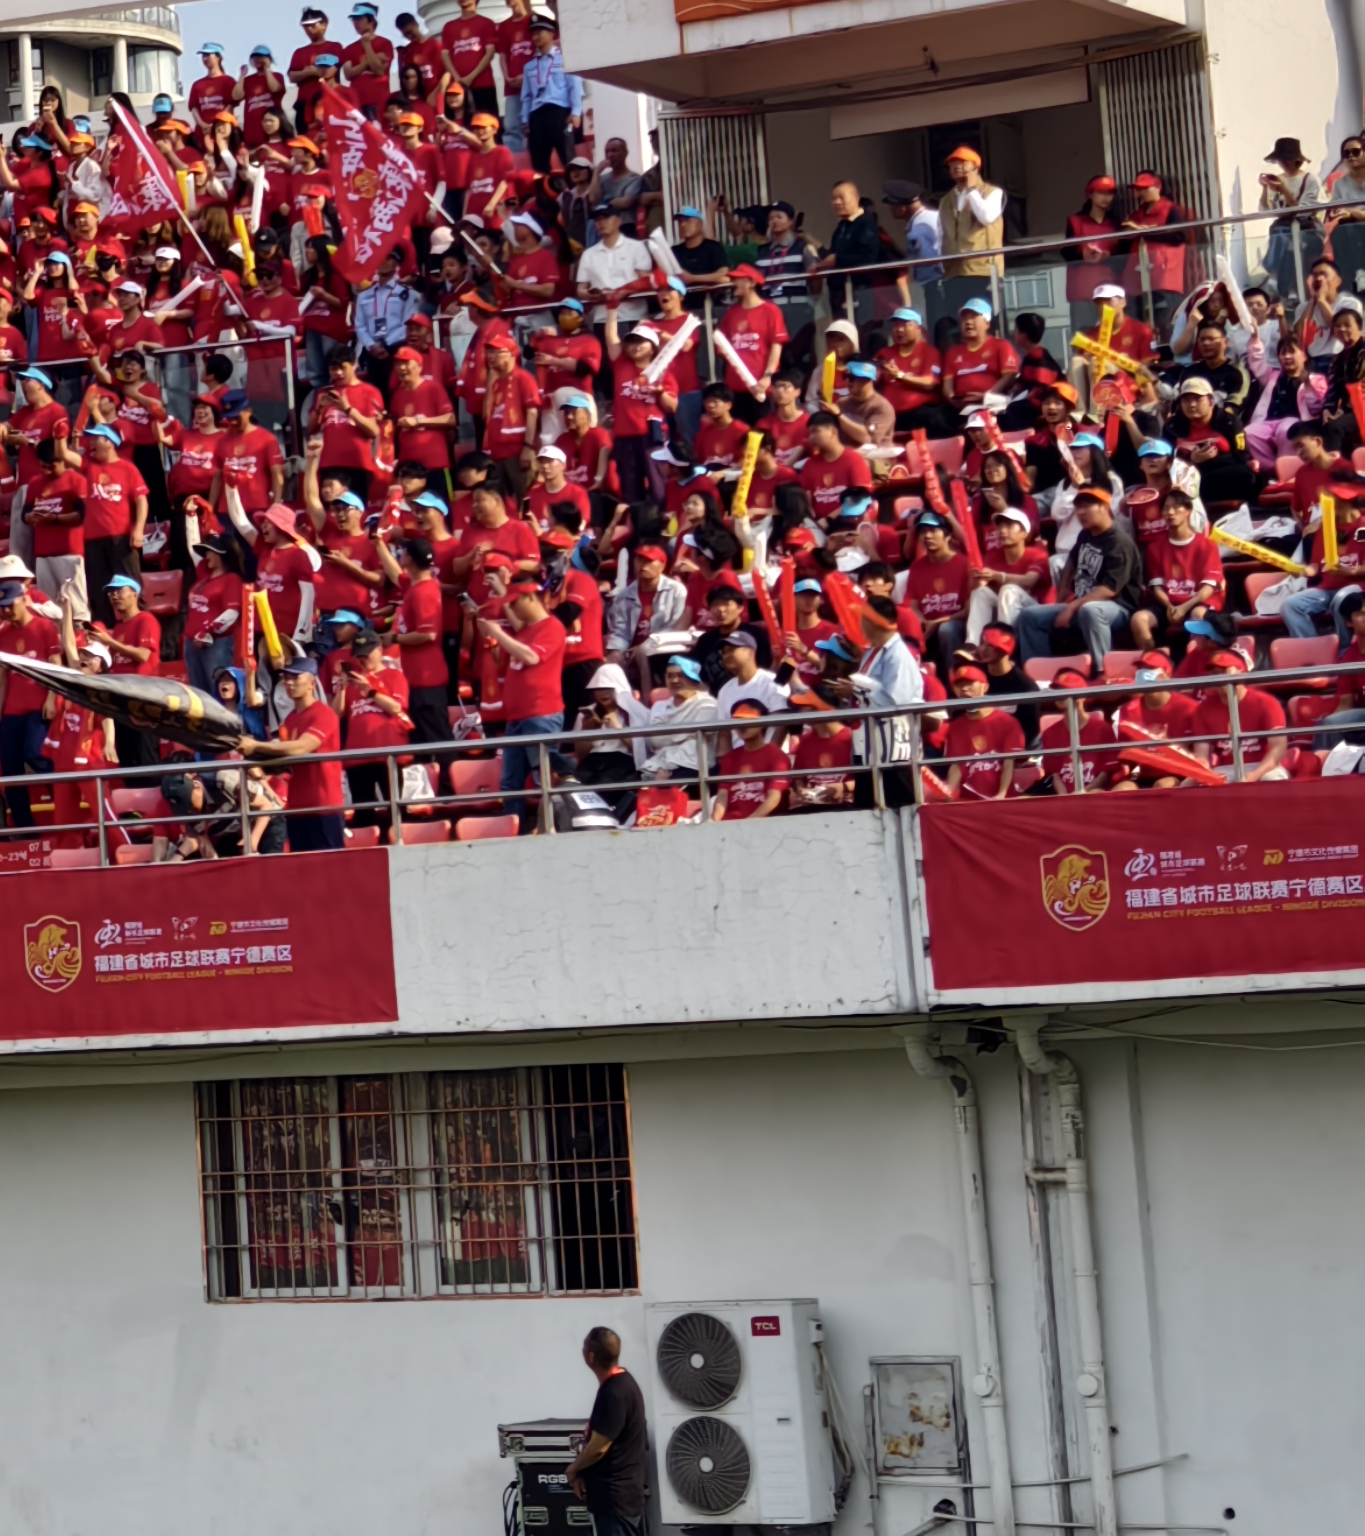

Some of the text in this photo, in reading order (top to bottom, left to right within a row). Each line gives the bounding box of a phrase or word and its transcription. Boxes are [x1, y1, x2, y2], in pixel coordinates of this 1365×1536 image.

[1125, 874, 1364, 908] 福建省城市足球联赛宁德赛区
[94, 945, 292, 972] 福建省城市足球联赛宁德赛区
[754, 1322, 777, 1331] TCL
